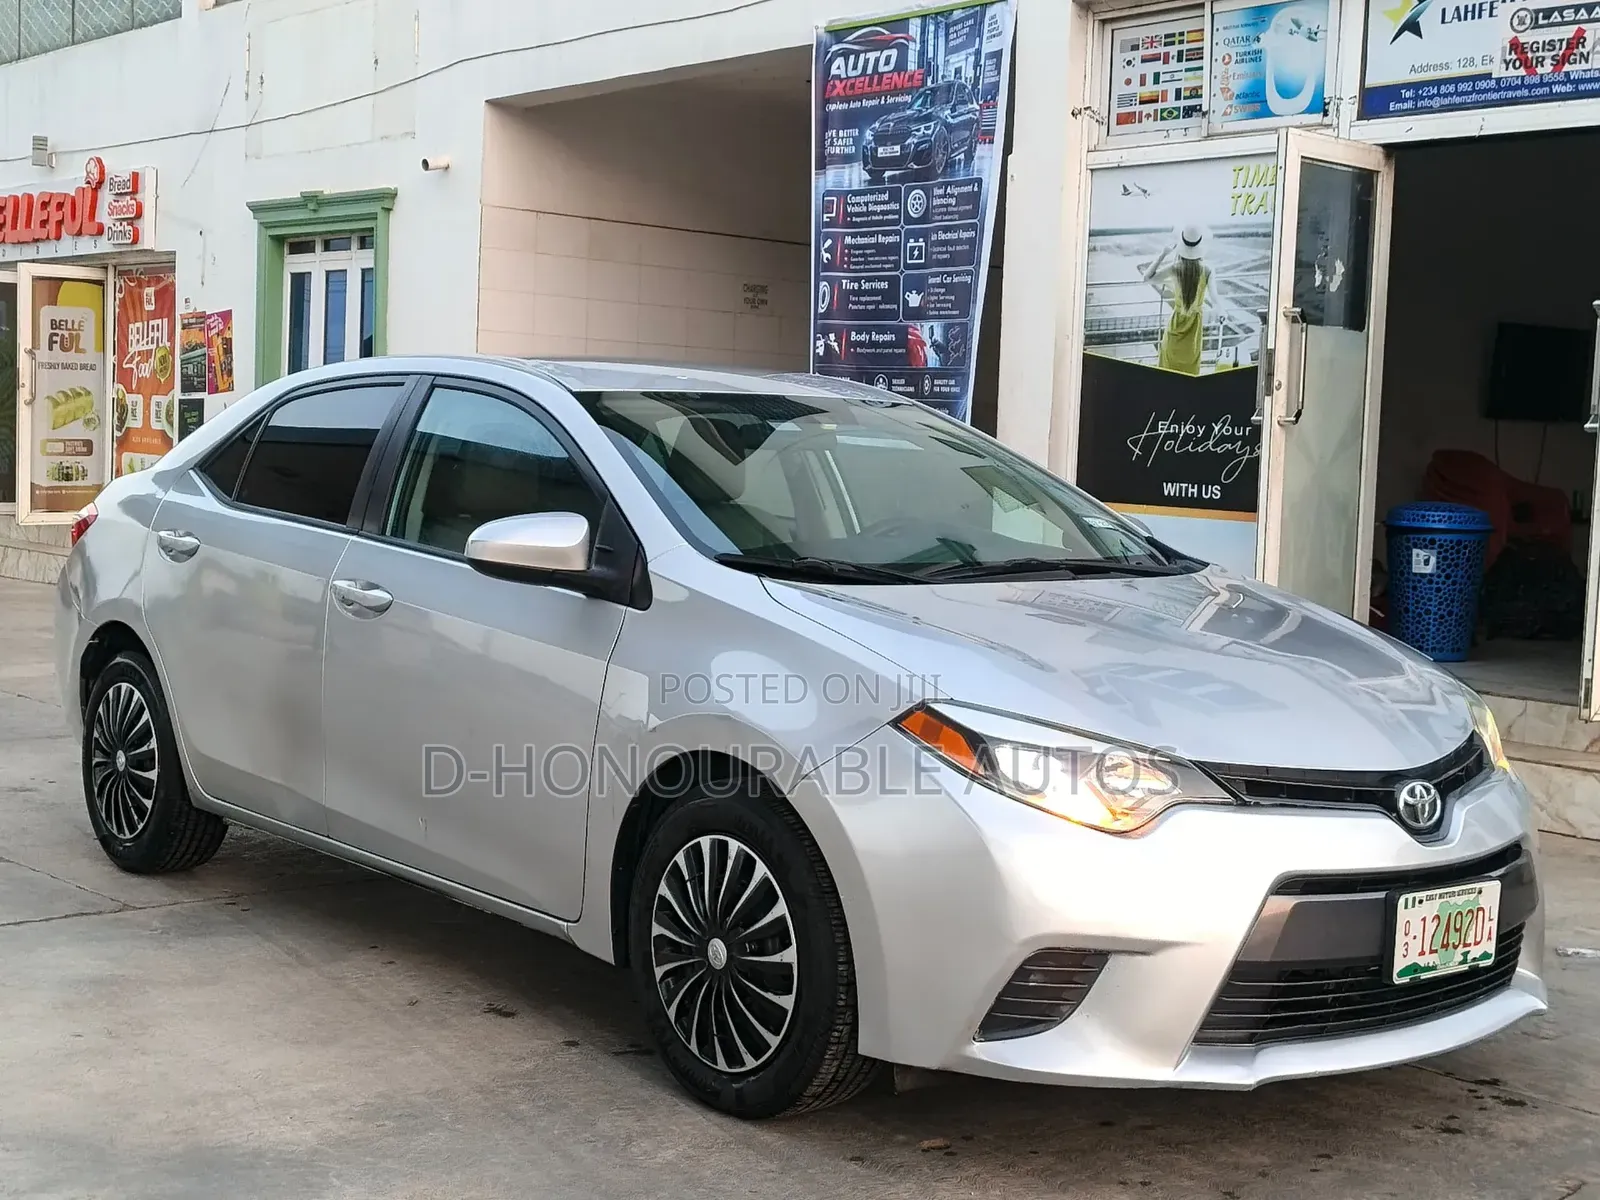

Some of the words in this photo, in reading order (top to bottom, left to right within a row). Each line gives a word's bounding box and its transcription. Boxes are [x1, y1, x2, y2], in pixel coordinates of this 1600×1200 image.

[1440, 1, 1498, 25] LAHFE
[1223, 35, 1251, 47] QATAR
[1508, 36, 1587, 56] REGISTER
[1234, 55, 1262, 65] AIRLINES
[1235, 49, 1263, 58] TURKISH
[1503, 55, 1545, 71] YOUR
[1550, 51, 1590, 67] SIGN
[828, 48, 898, 79] AUTO
[1409, 61, 1453, 75] Address:
[1456, 57, 1478, 69] 128,
[1481, 54, 1495, 66] Ek
[825, 68, 925, 98] EXCELLENCE
[1400, 89, 1416, 99] Tel:
[1417, 85, 1438, 97] +234
[1439, 84, 1456, 95] 806
[1457, 81, 1473, 92] 992
[1474, 79, 1498, 91] 0908,
[1500, 77, 1522, 88] 0704
[1523, 74, 1541, 85] 898
[1569, 69, 1600, 80] Whats
[848, 99, 861, 109] Auto
[862, 97, 880, 108] Repair
[885, 93, 912, 104] Servicing
[1389, 101, 1416, 112] Email:
[1552, 83, 1576, 94] Web:
[833, 137, 854, 146] SAFER
[838, 128, 859, 138] BETTER
[827, 146, 856, 155] FURTHER
[108, 174, 132, 192] Bread
[946, 183, 973, 196] Alignment
[973, 182, 979, 192] &
[847, 190, 889, 205] Computerized
[1231, 191, 1274, 216] TRA
[107, 198, 135, 217] Snacks
[846, 203, 867, 213] Vehicle
[868, 201, 900, 213] Diagnostics
[107, 223, 132, 242] Drinks
[844, 233, 878, 245] Mechanical
[877, 233, 900, 245] Repairs
[841, 279, 859, 290] Tire
[860, 279, 889, 290] Services
[942, 274, 952, 283] Car
[50, 318, 85, 331] BELLE
[48, 332, 87, 354] FUL
[128, 318, 171, 353] BELLEFUL
[850, 331, 870, 343] Body
[871, 330, 896, 343] Repairs
[37, 361, 60, 370] FRESHLY
[61, 362, 79, 371] BAKED
[79, 362, 97, 371] BREAD
[123, 348, 156, 390] Food
[1158, 420, 1206, 437] Enjoy
[1211, 422, 1252, 437] Your
[1127, 409, 1262, 483] Holidays
[1163, 482, 1198, 498] WITH
[1202, 484, 1222, 499] US
[1417, 906, 1486, 957] 12492D
